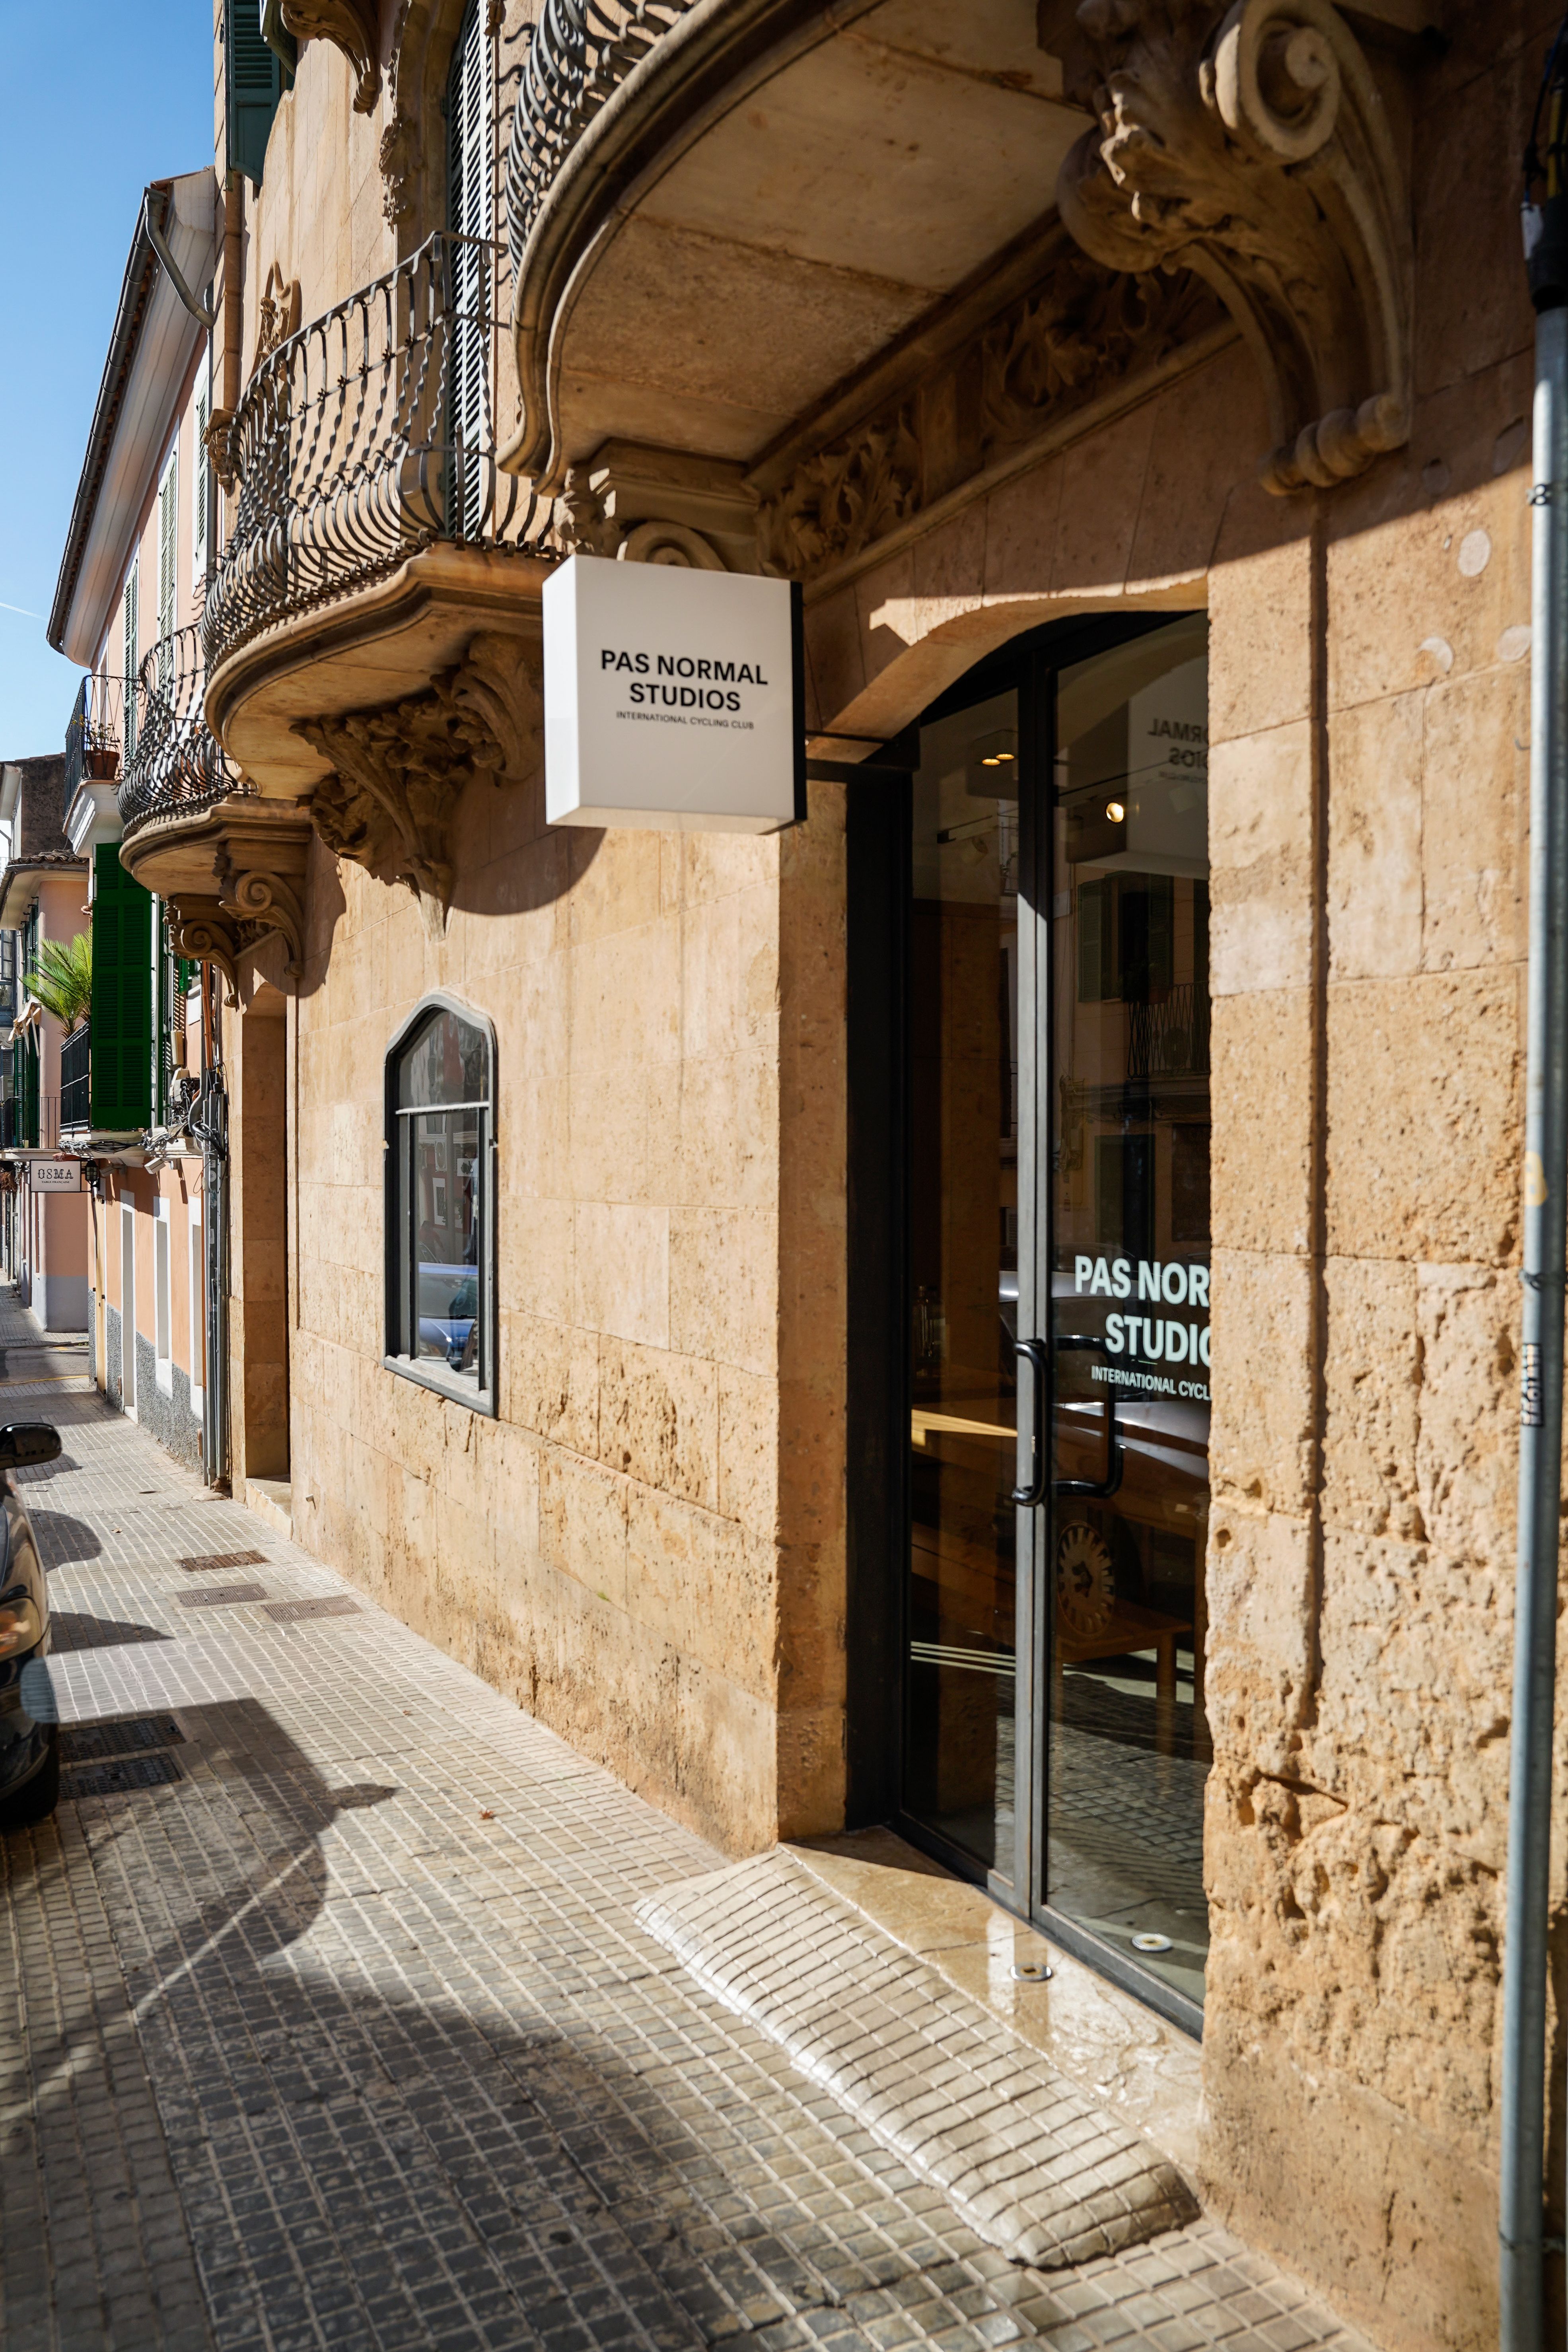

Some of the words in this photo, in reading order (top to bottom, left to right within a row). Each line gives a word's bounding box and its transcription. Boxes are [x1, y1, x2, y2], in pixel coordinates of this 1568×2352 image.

[601, 649, 650, 673] PAS
[658, 656, 768, 685] NORMAL
[630, 683, 740, 711] STUDIOS
[617, 711, 687, 725] INTERNATIONAL
[690, 717, 729, 728] CYCLING
[731, 720, 754, 730] CLUB
[38, 1169, 73, 1179] OSMA
[1075, 1255, 1131, 1298] PAS
[1091, 1365, 1177, 1395] INTERNATIONAL
